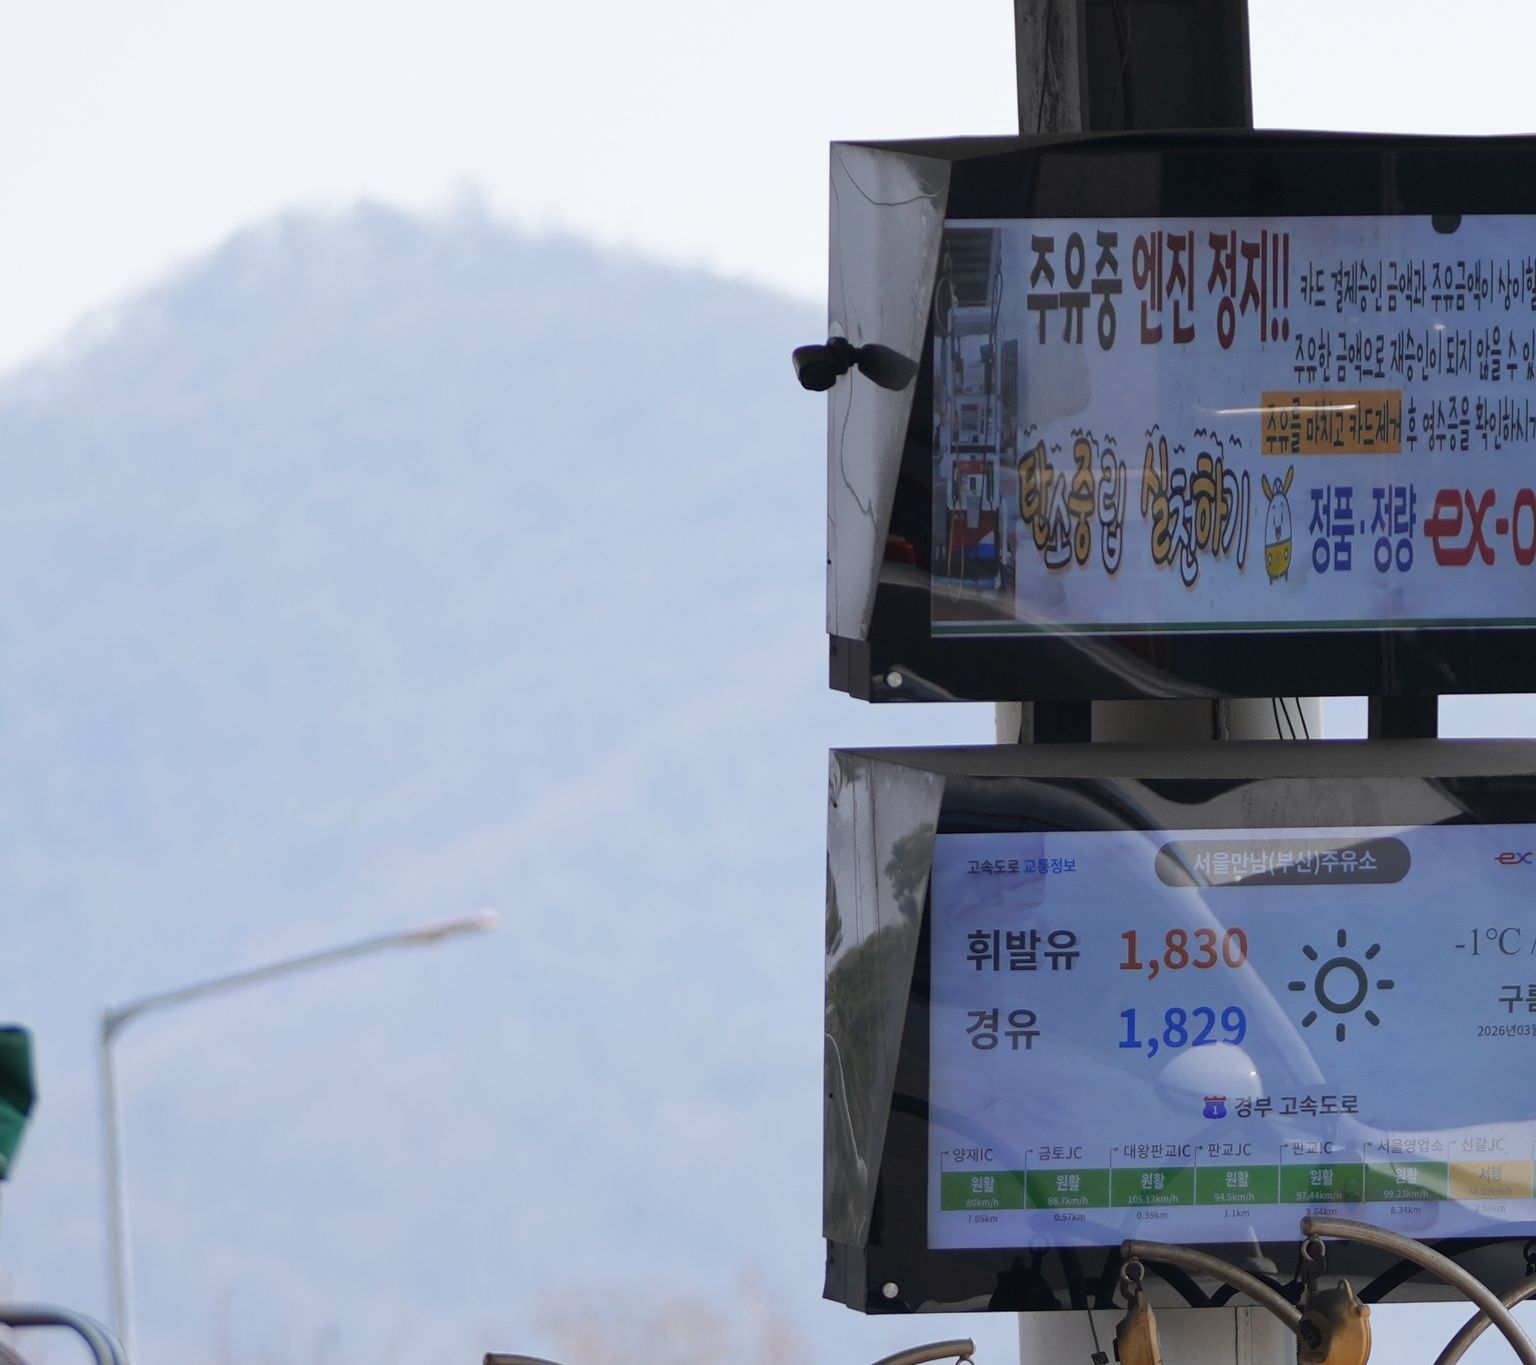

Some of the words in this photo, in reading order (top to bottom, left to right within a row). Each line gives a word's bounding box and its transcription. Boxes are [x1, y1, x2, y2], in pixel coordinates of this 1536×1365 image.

[1027, 230, 1123, 350] 주유중
[1132, 230, 1195, 344] 엔진
[1207, 230, 1290, 349] 정지!!
[1300, 260, 1326, 306] 카드
[1331, 258, 1382, 312] 결제승인
[1387, 260, 1427, 312] 금액과
[1431, 260, 1494, 312] 주유금액이
[1294, 328, 1331, 383] 주유한
[1336, 330, 1385, 383] 금액으로
[1391, 328, 1441, 382] 재승인이
[1446, 329, 1472, 377] 되지
[1476, 325, 1502, 381] 않을
[1506, 330, 1518, 380] 수
[1266, 398, 1301, 452] 주유를
[1306, 398, 1344, 447] 마치고
[1350, 398, 1401, 445] 카드제거
[1406, 396, 1417, 451] 후
[1423, 396, 1470, 451] 영수증을
[1019, 437, 1127, 575] 탄소중립
[1141, 435, 1251, 587] 실천하기
[967, 858, 1020, 874] 고속도로
[1023, 857, 1077, 874] 교통정보
[1193, 850, 1378, 877] 서울만남(부산)주유소
[966, 929, 1081, 972] 휘발유
[1119, 927, 1249, 980] 1,830
[965, 1008, 1041, 1051] 경유
[1118, 1004, 1248, 1058] 1,829
[1234, 1096, 1274, 1118] 경부
[1278, 1095, 1360, 1117] 고속도로
[1123, 1144, 1191, 1159] 대왕판교IC
[1208, 1142, 1252, 1157] 판교JC
[1376, 1138, 1444, 1154] 서울영업소
[1461, 1137, 1504, 1152] 신갈JC
[953, 1147, 993, 1162] 양재IC
[1038, 1146, 1083, 1161] 금토JC
[1056, 1174, 1080, 1192] 원활
[1141, 1173, 1165, 1190] 원활
[1224, 1170, 1249, 1188] 원활
[1310, 1169, 1334, 1186] 원활
[1395, 1167, 1418, 1184] 원활
[971, 1176, 994, 1193] 원활
[1223, 1209, 1250, 1218] 1.1km
[1390, 1205, 1421, 1215] 8.34km
